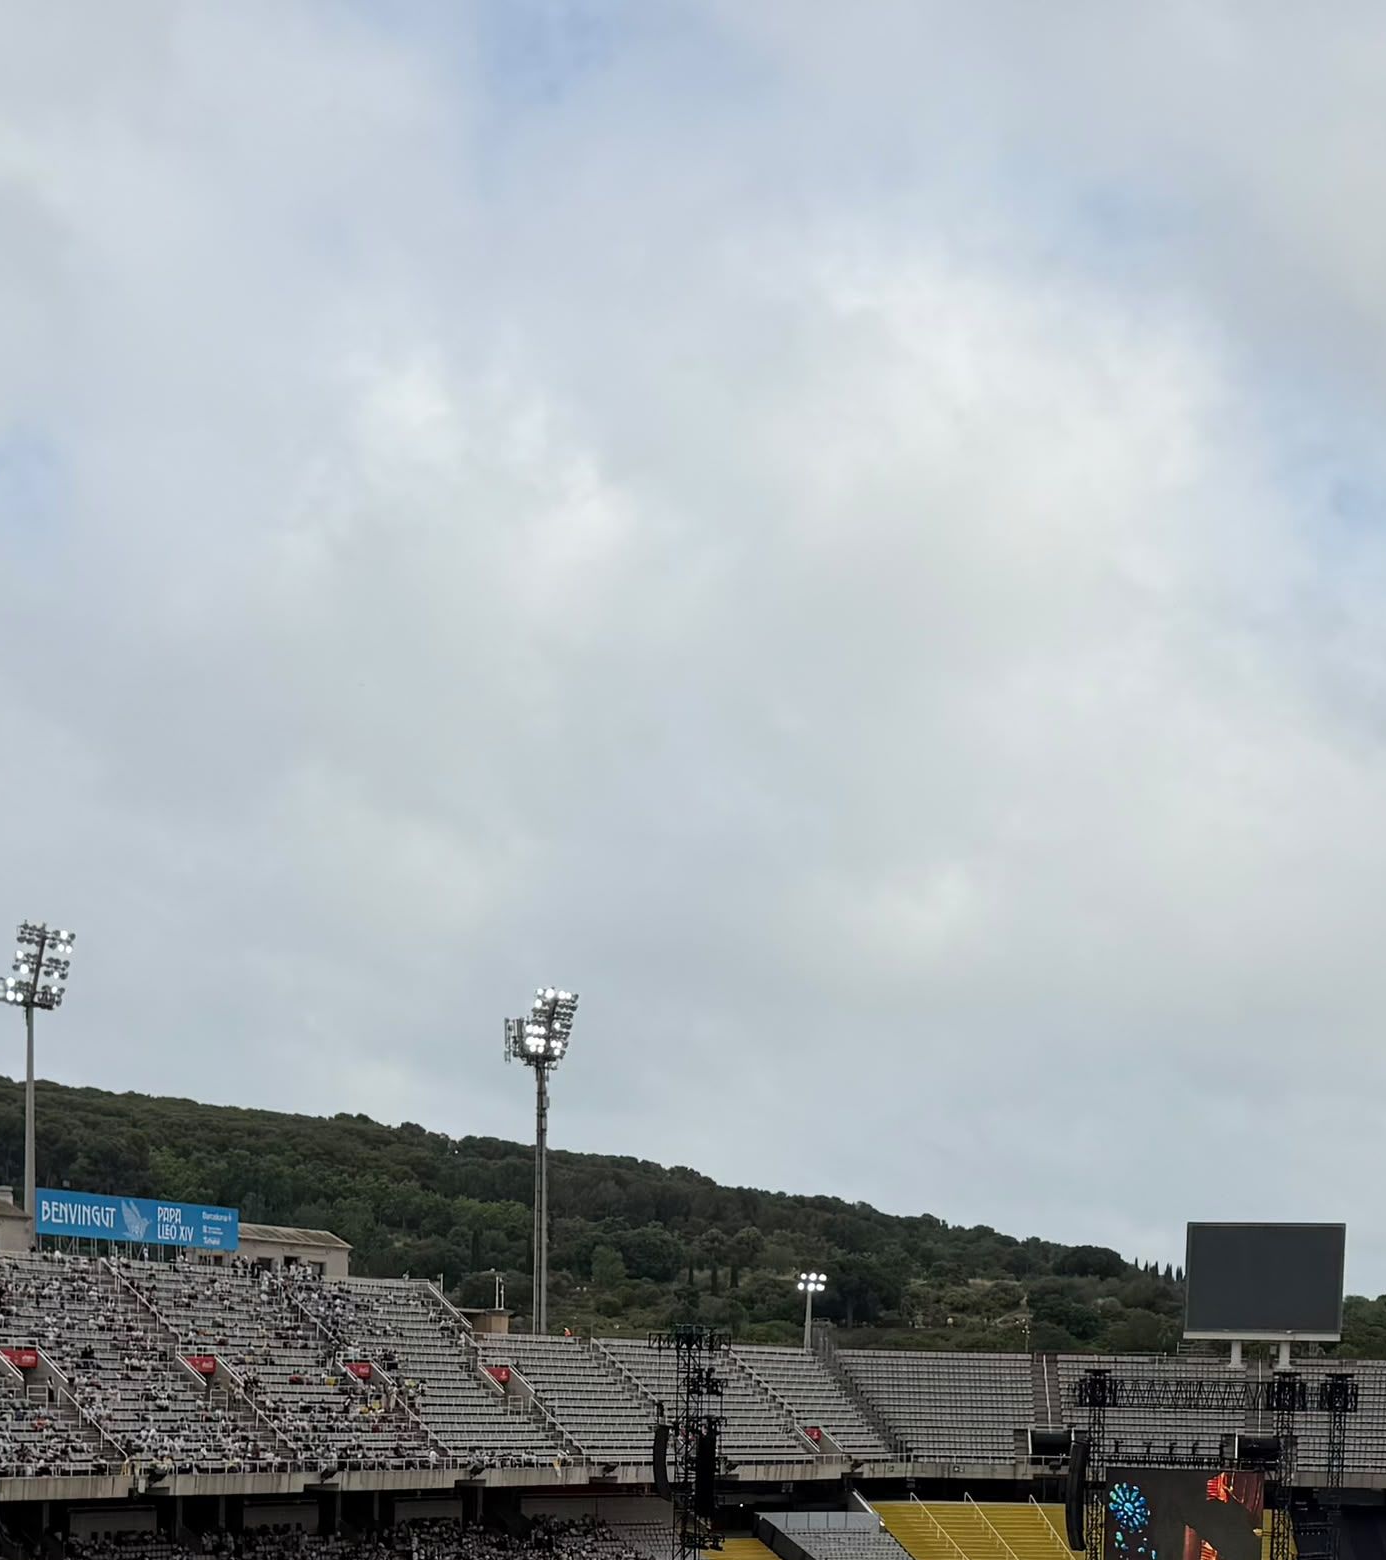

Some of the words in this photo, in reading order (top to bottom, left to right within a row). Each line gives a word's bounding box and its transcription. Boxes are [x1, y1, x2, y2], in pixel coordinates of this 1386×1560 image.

[41, 1200, 116, 1228] BENVINGUT
[157, 1206, 181, 1225] PAPA
[157, 1222, 177, 1241] LLEÓ
[179, 1225, 194, 1242] XIV
